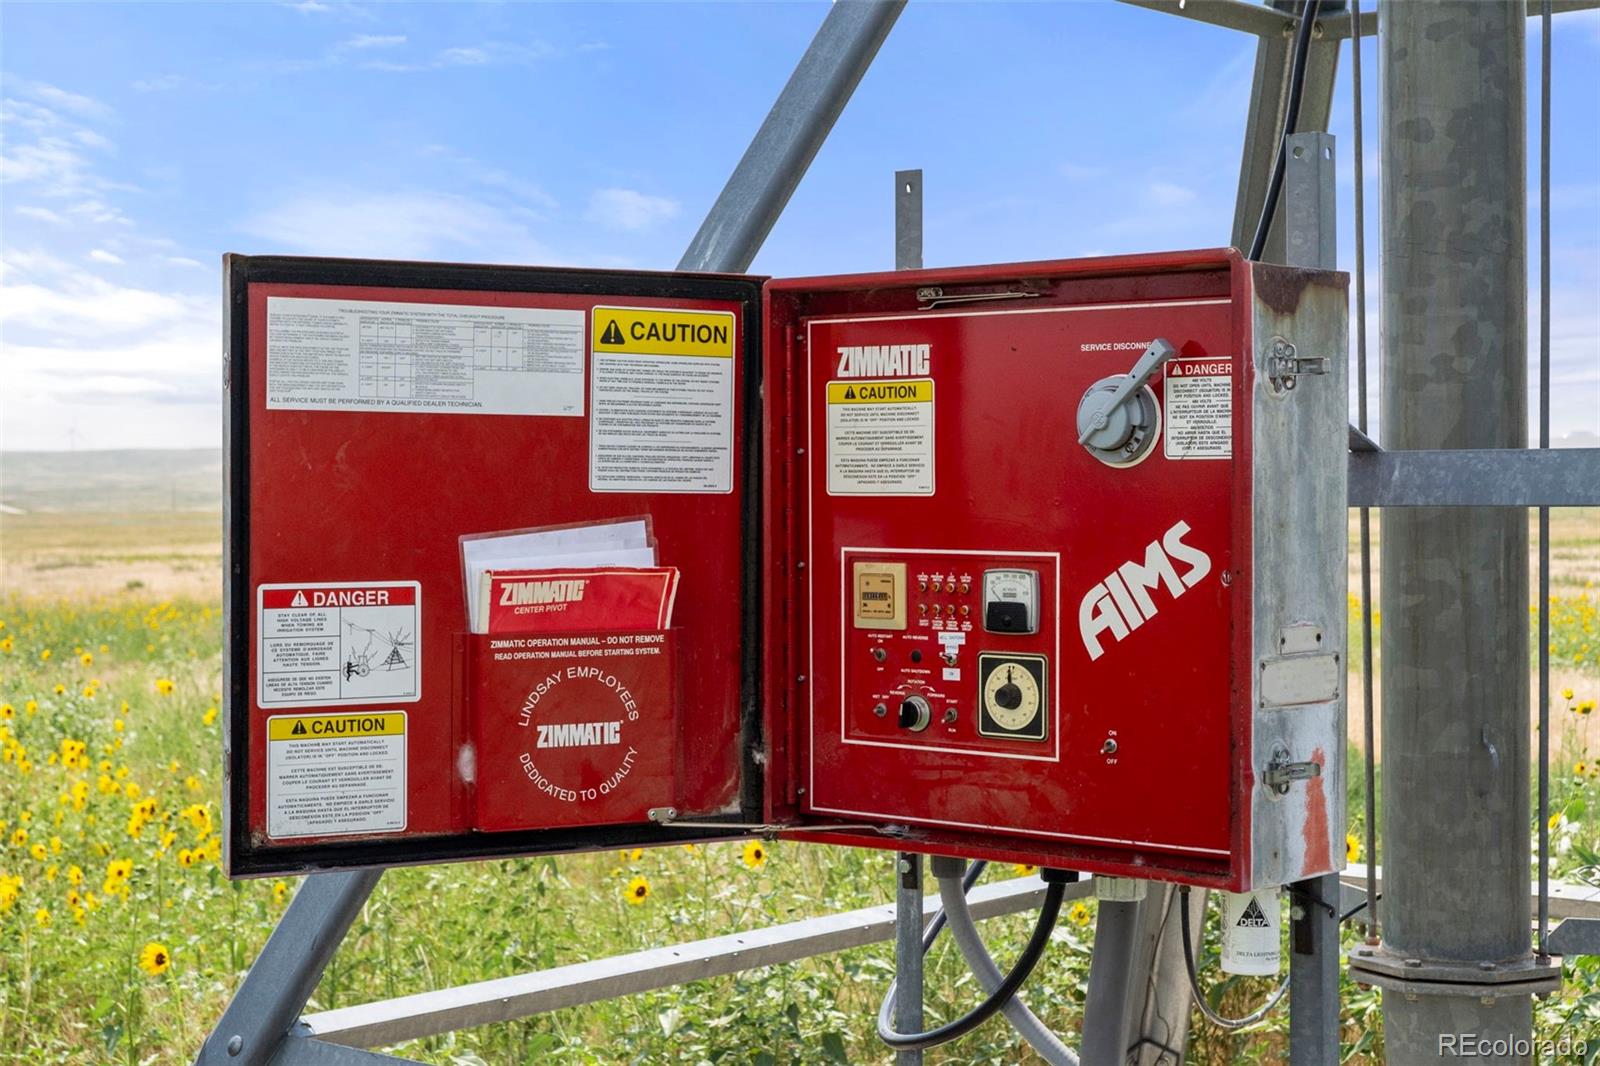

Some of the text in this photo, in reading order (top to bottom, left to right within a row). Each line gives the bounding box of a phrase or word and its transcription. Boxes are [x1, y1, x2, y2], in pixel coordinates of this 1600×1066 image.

[630, 321, 727, 344] CAUTION
[1080, 341, 1152, 352] SERVICE DISCONNE
[837, 344, 930, 377] ZIMMATIC
[1185, 363, 1232, 375] DANGER
[859, 385, 916, 400] CAUTION
[500, 580, 585, 606] ZIMMATIC
[1078, 519, 1211, 662] AIMS
[313, 592, 389, 606] DANGER
[514, 603, 568, 614] CENTER PIVOT
[490, 640, 526, 649] ZIMMATIC
[527, 638, 569, 647] OPERATION
[570, 637, 600, 645] MANUAL
[607, 636, 618, 644] DO
[619, 635, 634, 644] NOT
[635, 634, 665, 643] REMOVE
[513, 651, 550, 660] OPERATION
[551, 650, 577, 658] MANUAL
[604, 648, 634, 656] STARTING
[518, 666, 640, 727] LINDSAY EMPLOYEES
[312, 718, 385, 734] CAUTION
[537, 720, 620, 748] ZIMMATIC
[520, 746, 638, 802] DEDICATED TO QUALITY
[1240, 918, 1270, 927] DELTA
